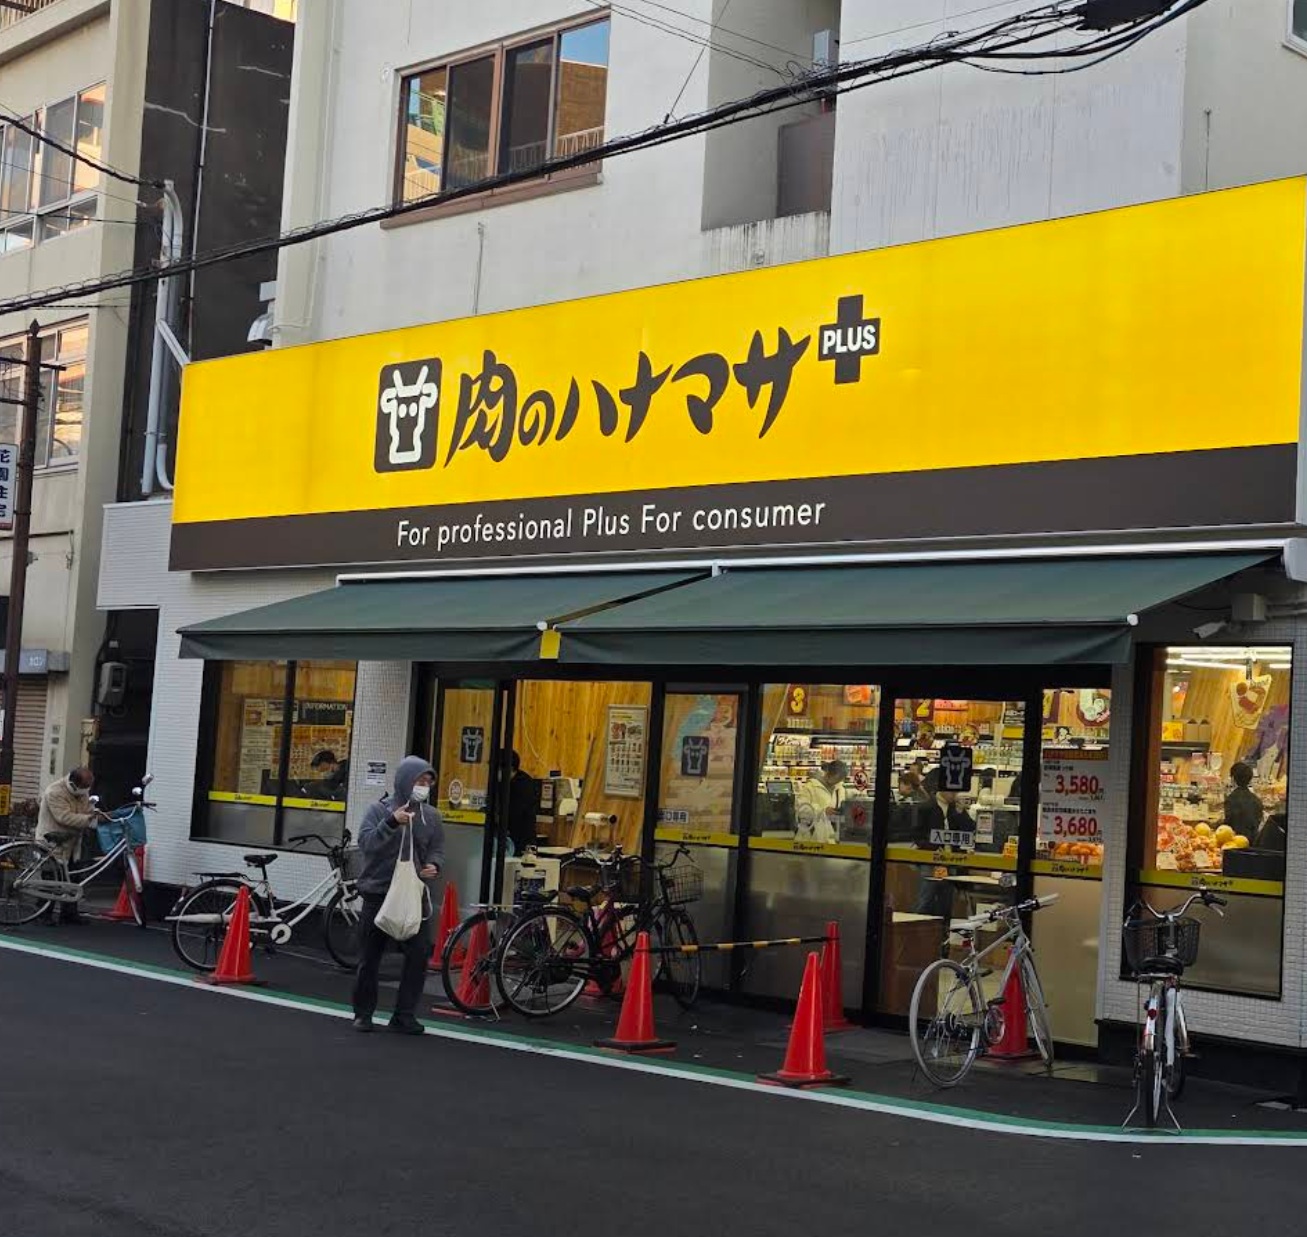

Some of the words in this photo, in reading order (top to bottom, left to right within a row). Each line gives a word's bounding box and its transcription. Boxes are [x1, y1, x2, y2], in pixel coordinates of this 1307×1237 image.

[823, 325, 876, 355] PLUS
[444, 327, 810, 468] 肉のハナマサ
[397, 520, 431, 547] For
[437, 508, 572, 552] professional
[582, 505, 630, 537] Plus
[641, 504, 682, 534] For
[692, 502, 826, 531] consumer
[790, 687, 805, 713] 3
